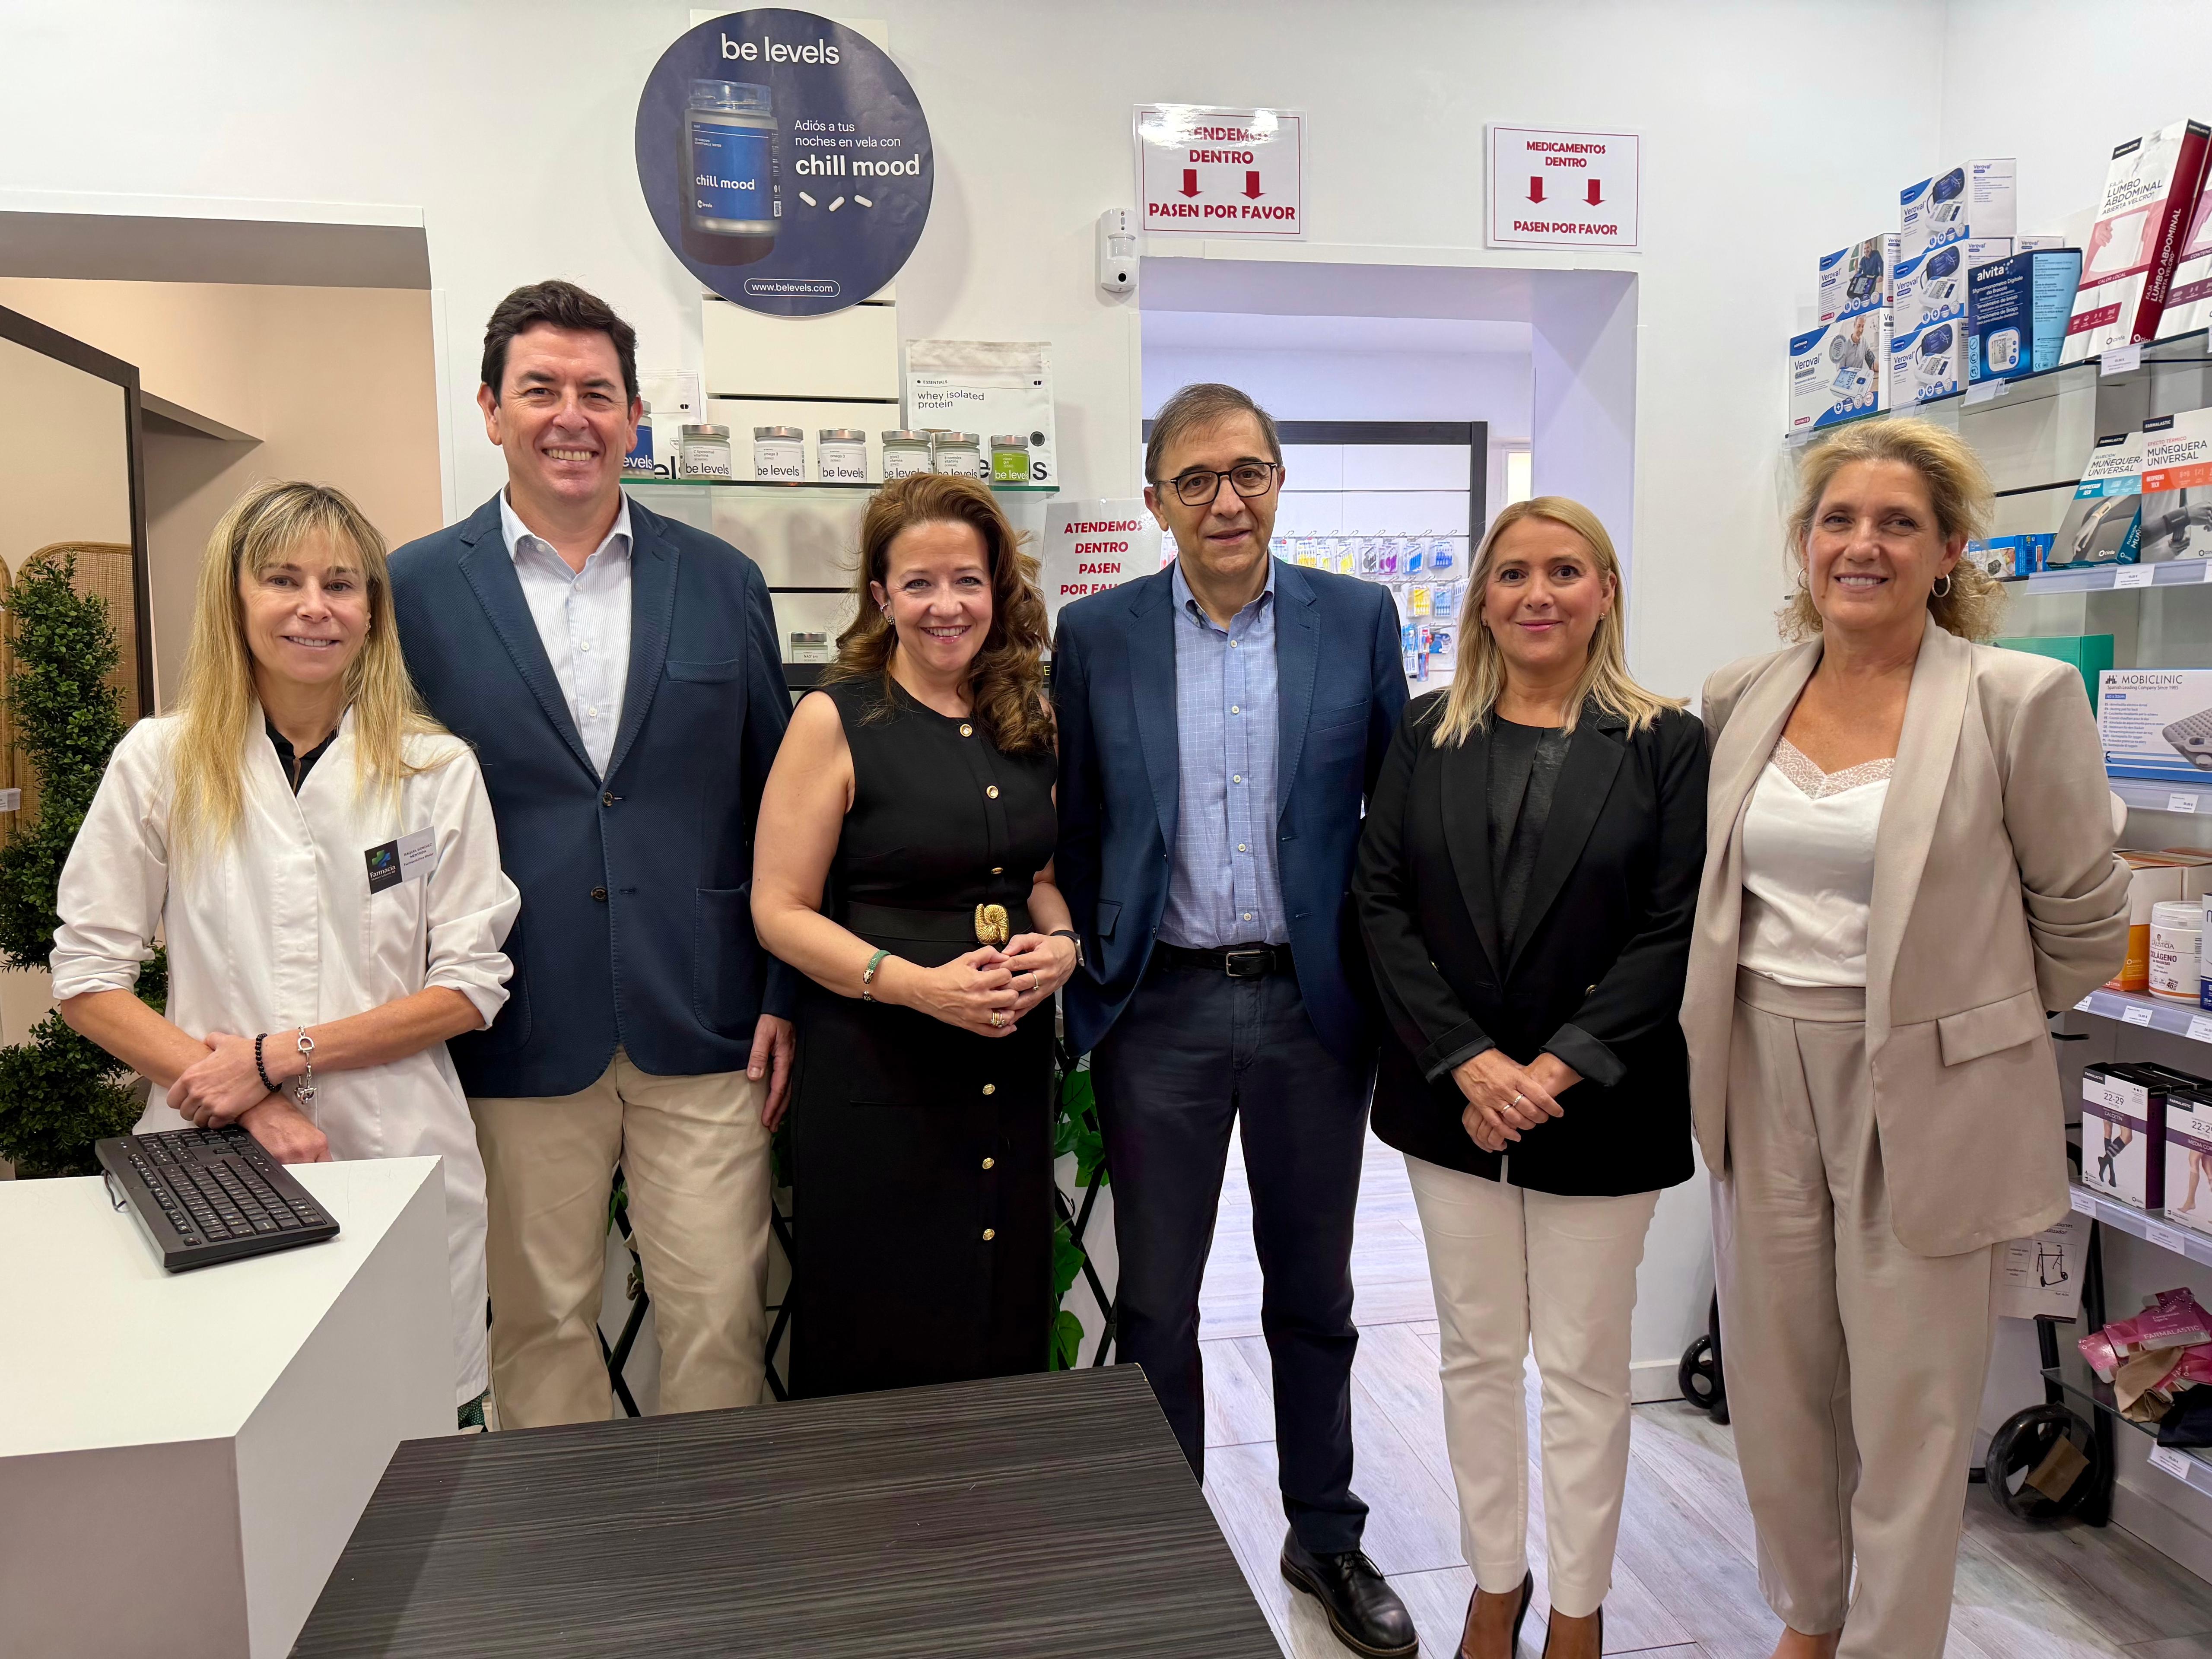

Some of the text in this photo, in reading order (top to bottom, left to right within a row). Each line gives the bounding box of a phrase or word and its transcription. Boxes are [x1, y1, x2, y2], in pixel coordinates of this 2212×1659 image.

[721, 33, 839, 64] be levels
[795, 120, 855, 132] Adiós a tus
[795, 136, 836, 147] noches
[855, 137, 877, 147] vela
[880, 138, 900, 147] con
[1526, 141, 1606, 154] MEDICAMENTOS
[1189, 149, 1254, 164] DENTRO
[1545, 157, 1587, 167] DENTRO
[795, 155, 919, 176] chill mood
[696, 175, 755, 190] chill mood
[2107, 178, 2141, 198] LUMBO
[2104, 180, 2163, 208] ABDOMINAL
[1149, 203, 1295, 220] PASEN POR FAVOR
[1904, 202, 1925, 216] Veroval
[2102, 202, 2126, 215] ABIERTA
[1514, 221, 1618, 235] PASEN POR FAVOR
[2151, 208, 2181, 302] LUMBO ABDOMINAL
[1821, 269, 1840, 281] Veroval
[1977, 266, 2004, 281] alvita
[2098, 272, 2126, 284] CALOR LOCAL
[752, 283, 833, 293] www.belevels.com
[1897, 276, 1918, 290] Veroval
[2158, 278, 2168, 303] ABIERTA
[1795, 353, 1820, 371] Veroval
[1895, 351, 1914, 363] Veroval
[918, 391, 984, 401] whey isolated
[918, 400, 953, 409] protein
[2145, 420, 2171, 429] FARMALASTIC
[2147, 440, 2208, 457] MUÑEQUERA
[2147, 451, 2199, 466] UNIVERSAL
[686, 463, 699, 474] be
[702, 463, 729, 475] levels
[757, 465, 799, 476] be levels
[823, 467, 864, 478] be levels
[884, 468, 893, 478] be
[995, 470, 1007, 479] be
[1009, 470, 1029, 480] levels
[2088, 465, 2134, 477] UNIVERSAL
[1064, 520, 1143, 534] ATENDEMOS
[2126, 524, 2138, 545] SUJECIÓN
[1075, 541, 1128, 553] DENTRO
[1079, 563, 1121, 574] PASEN
[1060, 584, 1087, 595] POR
[2121, 675, 2183, 684] MOBICLINIC
[370, 864, 396, 878] Farmacia
[2104, 1092, 2124, 1105] 22-29
[2192, 1121, 2212, 1134] 22-2
[2188, 1138, 2202, 1148] MEDIA
[2144, 1325, 2200, 1340] FARMALASTIC
